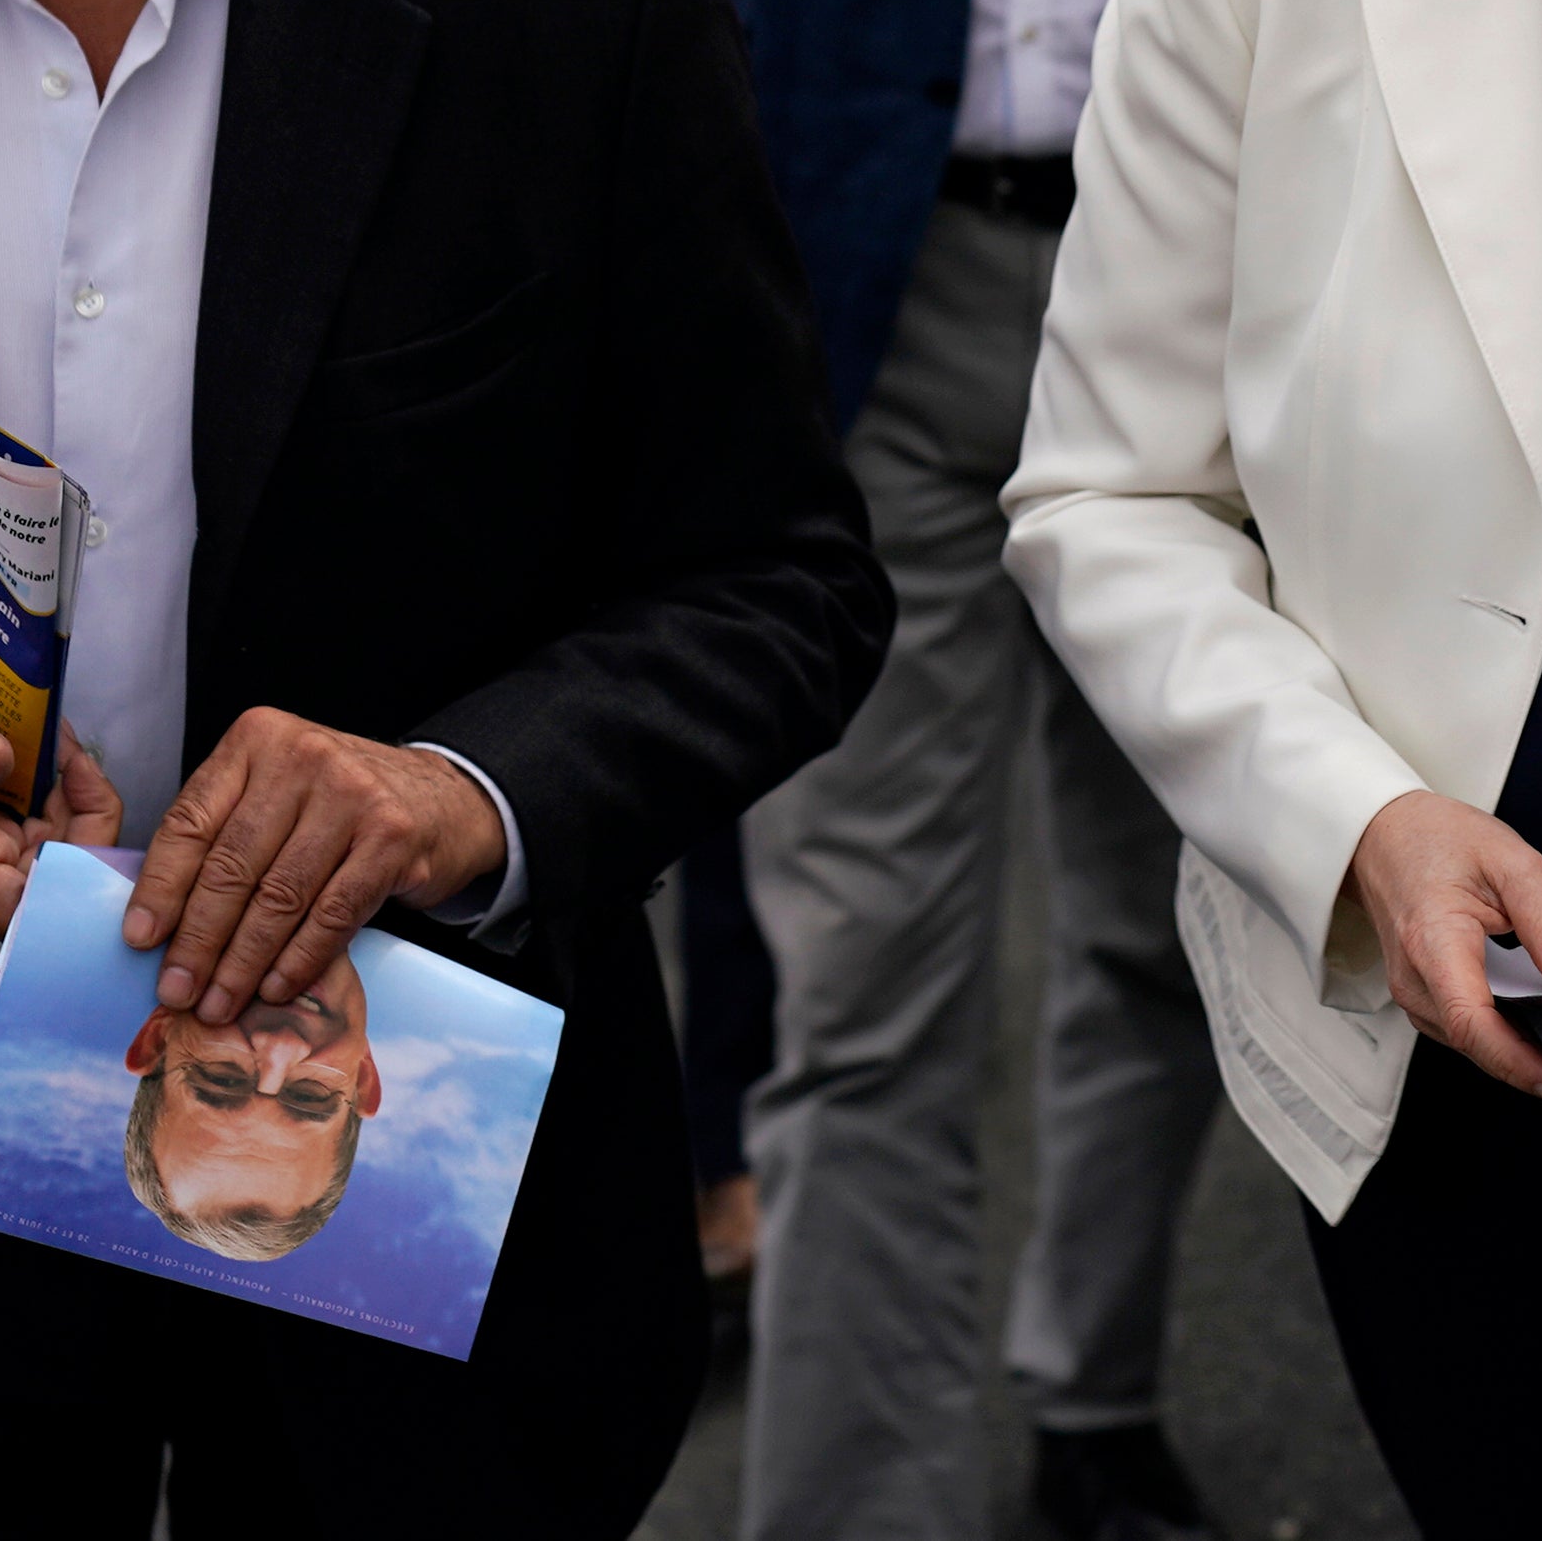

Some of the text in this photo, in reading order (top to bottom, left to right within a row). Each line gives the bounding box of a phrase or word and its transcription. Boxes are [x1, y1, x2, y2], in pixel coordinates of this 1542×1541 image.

[3, 505, 11, 520] à
[13, 512, 46, 531] faire
[9, 526, 46, 546] notre
[7, 559, 55, 580] Mariani
[5, 705, 22, 722] LES
[17, 1216, 42, 1230] JUIN
[44, 1224, 58, 1234] 27
[61, 1228, 74, 1239] ET
[75, 1232, 90, 1243] 20
[110, 1241, 149, 1260] D'AZUR
[290, 1291, 357, 1318] RÉGIONALES
[357, 1310, 415, 1335] ÉLECTIONS
